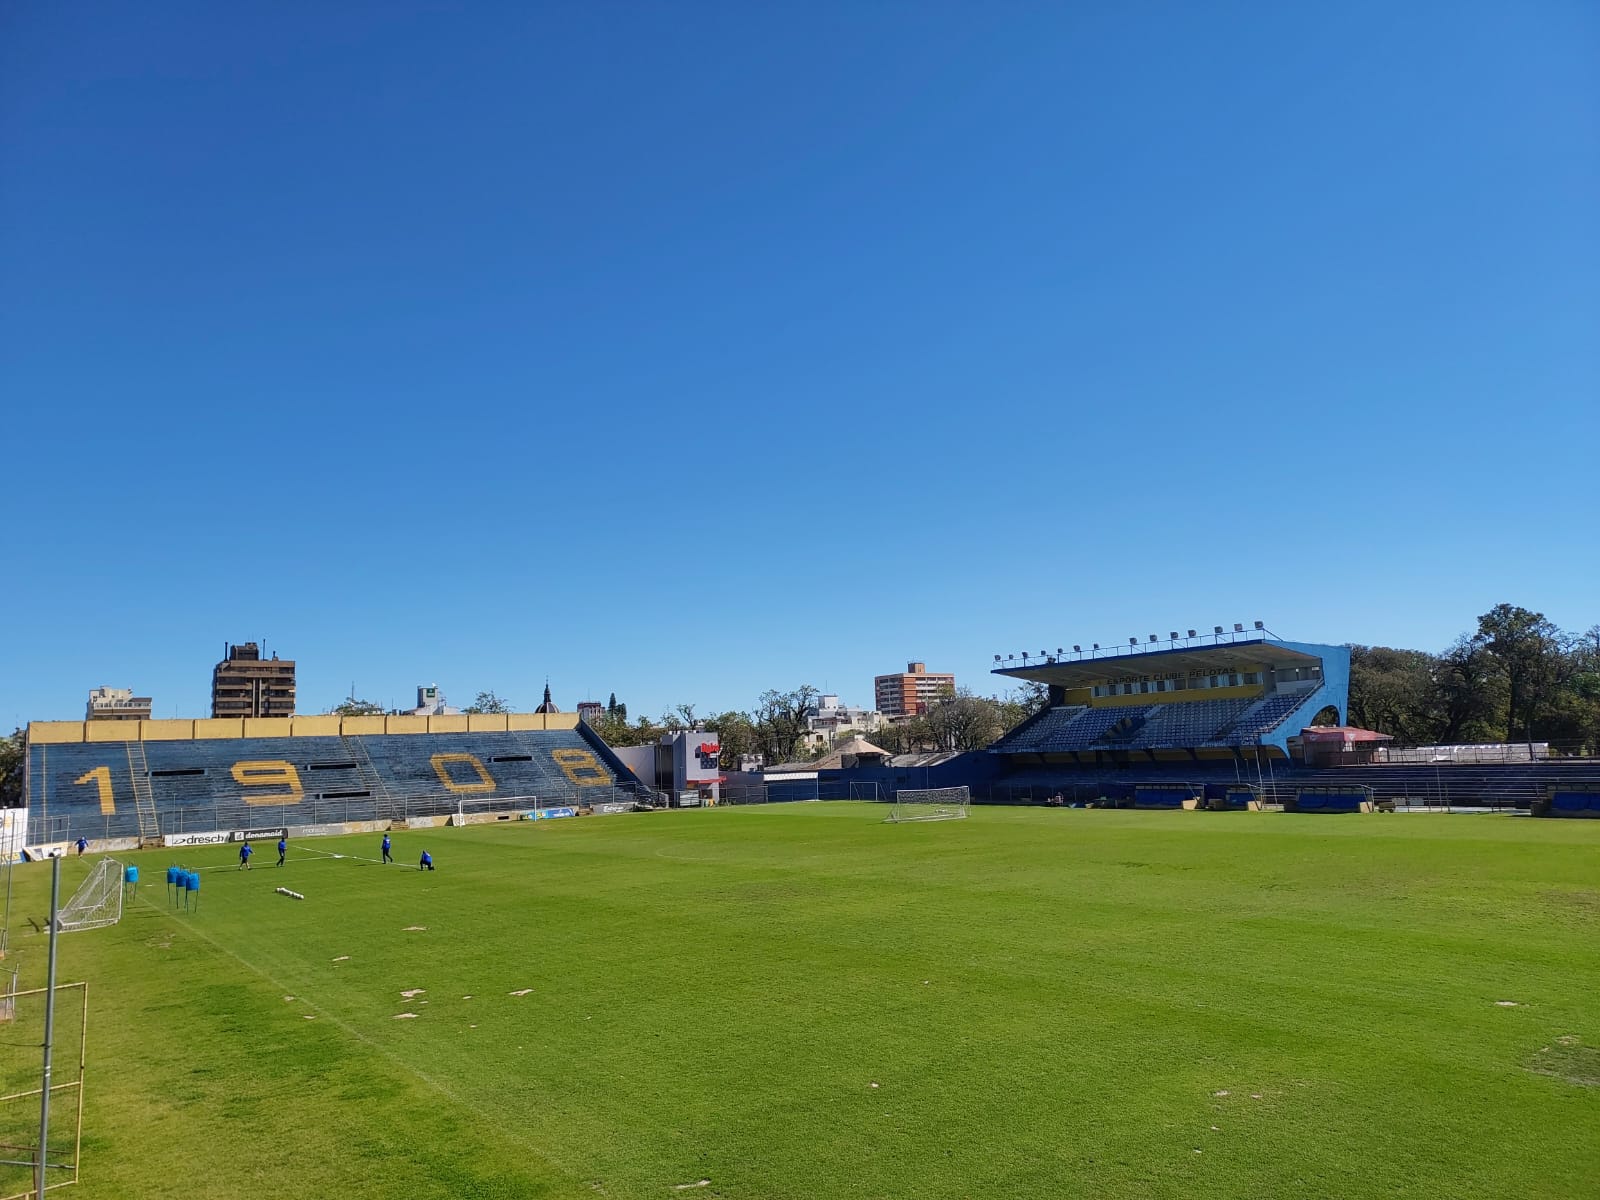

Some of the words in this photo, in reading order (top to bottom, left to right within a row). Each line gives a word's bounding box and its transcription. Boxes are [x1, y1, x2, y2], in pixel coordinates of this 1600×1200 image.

[1107, 675, 1150, 685] ESPORTE
[1153, 671, 1185, 681] CLUBE
[1189, 667, 1236, 678] PELOTAS
[74, 766, 116, 816] 1
[230, 760, 305, 806] 9
[551, 748, 613, 787] 8
[186, 834, 225, 844] dresch
